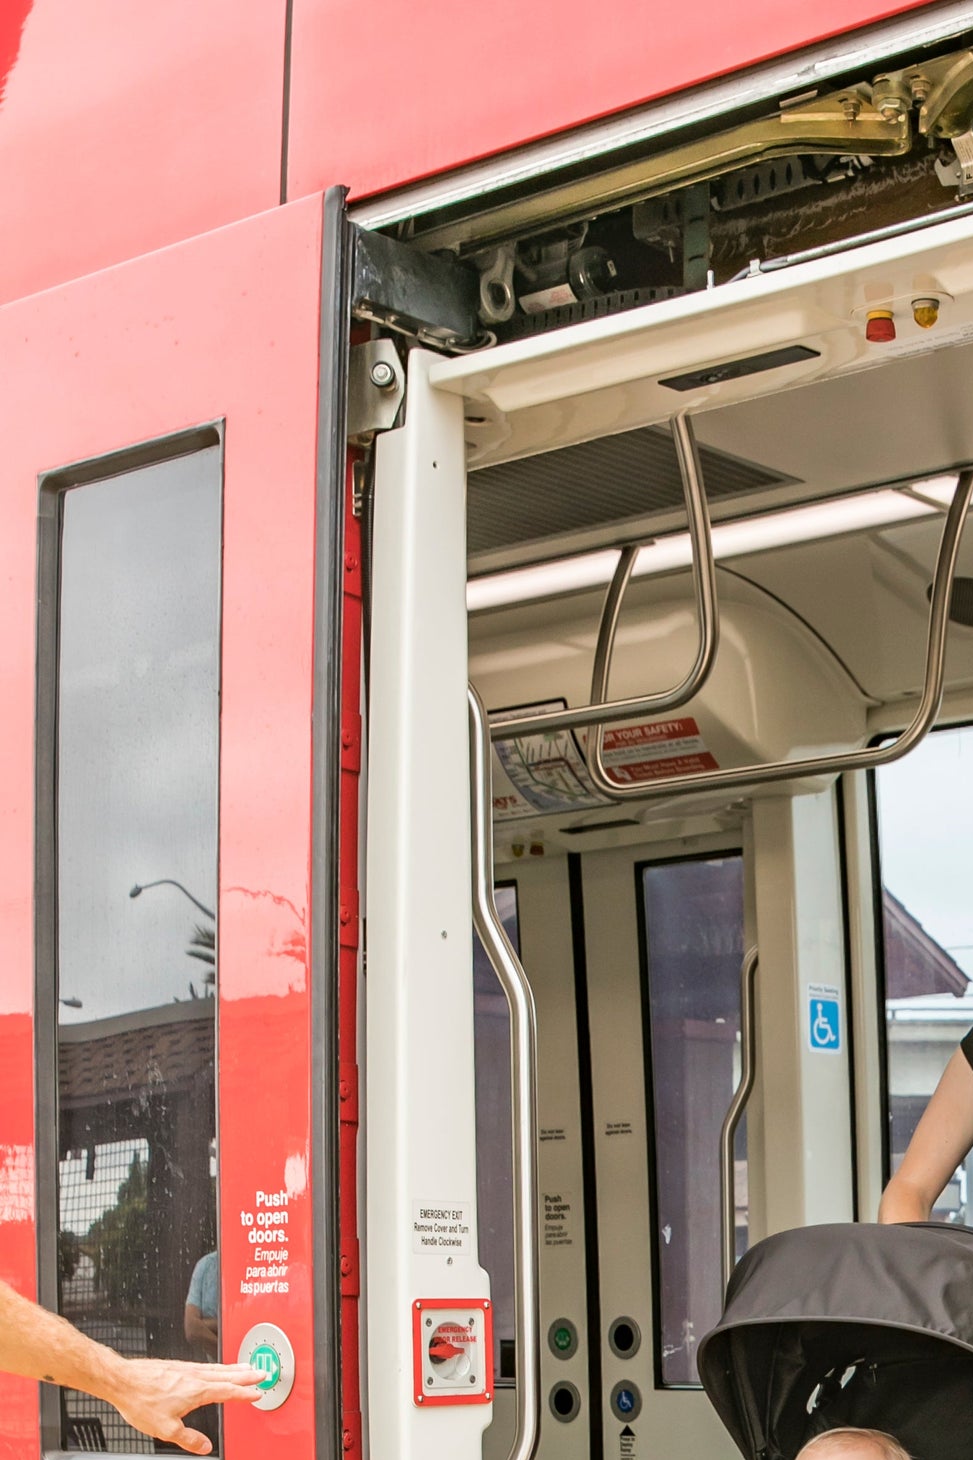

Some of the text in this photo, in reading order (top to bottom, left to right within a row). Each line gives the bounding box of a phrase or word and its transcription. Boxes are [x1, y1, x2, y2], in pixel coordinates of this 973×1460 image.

[616, 728, 642, 740] YOUR
[256, 1190, 288, 1208] Push
[544, 1194, 562, 1203] Push
[240, 1210, 288, 1228] to open
[420, 1208, 462, 1220] EMERGENCY EXIT
[248, 1228, 288, 1244] doors.
[414, 1222, 469, 1234] Remove Cover and Turn
[421, 1236, 462, 1247] Handle Clockwise
[254, 1246, 288, 1264] Empuje
[246, 1263, 288, 1280] para abrir
[240, 1280, 289, 1296] las puertas
